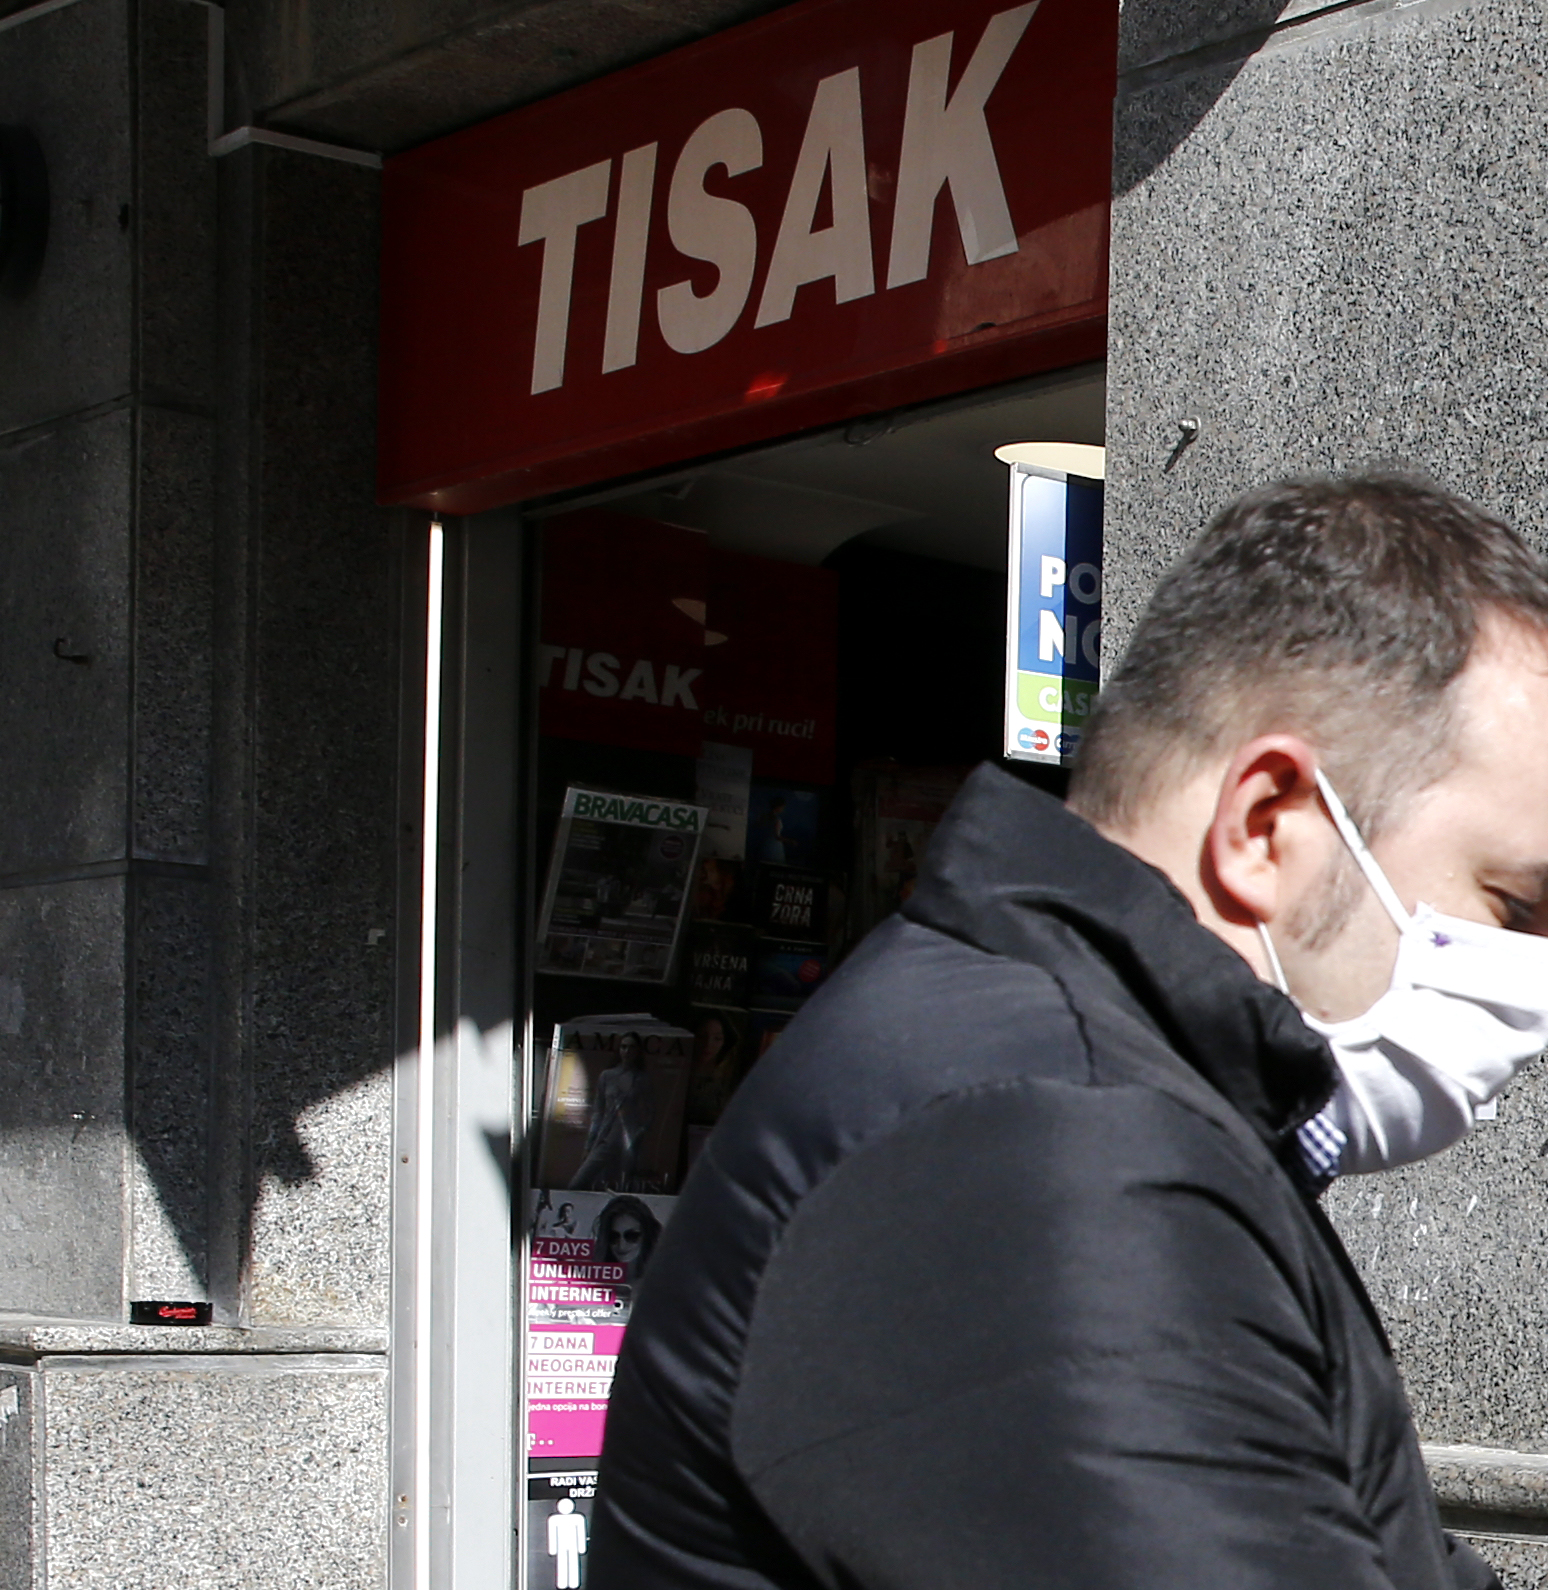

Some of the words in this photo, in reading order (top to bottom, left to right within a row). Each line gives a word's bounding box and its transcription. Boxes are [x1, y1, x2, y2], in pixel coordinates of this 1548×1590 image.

[517, 0, 1041, 396] TISAK
[539, 643, 704, 711] TISAK
[732, 711, 764, 735] pri
[573, 793, 698, 831] BRAVACASA
[774, 883, 813, 907] CRNA
[769, 902, 812, 928] ZORA
[567, 1031, 684, 1056] AMCA
[536, 1241, 544, 1255] 7
[549, 1242, 590, 1256] DAYS
[533, 1263, 623, 1280] UNLIMITED
[531, 1285, 613, 1302] INTERNET
[530, 1336, 538, 1349] 7
[544, 1336, 588, 1350] DANA
[528, 1403, 551, 1412] jedna
[552, 1403, 577, 1412] opcija
[550, 1477, 577, 1487] RADI
